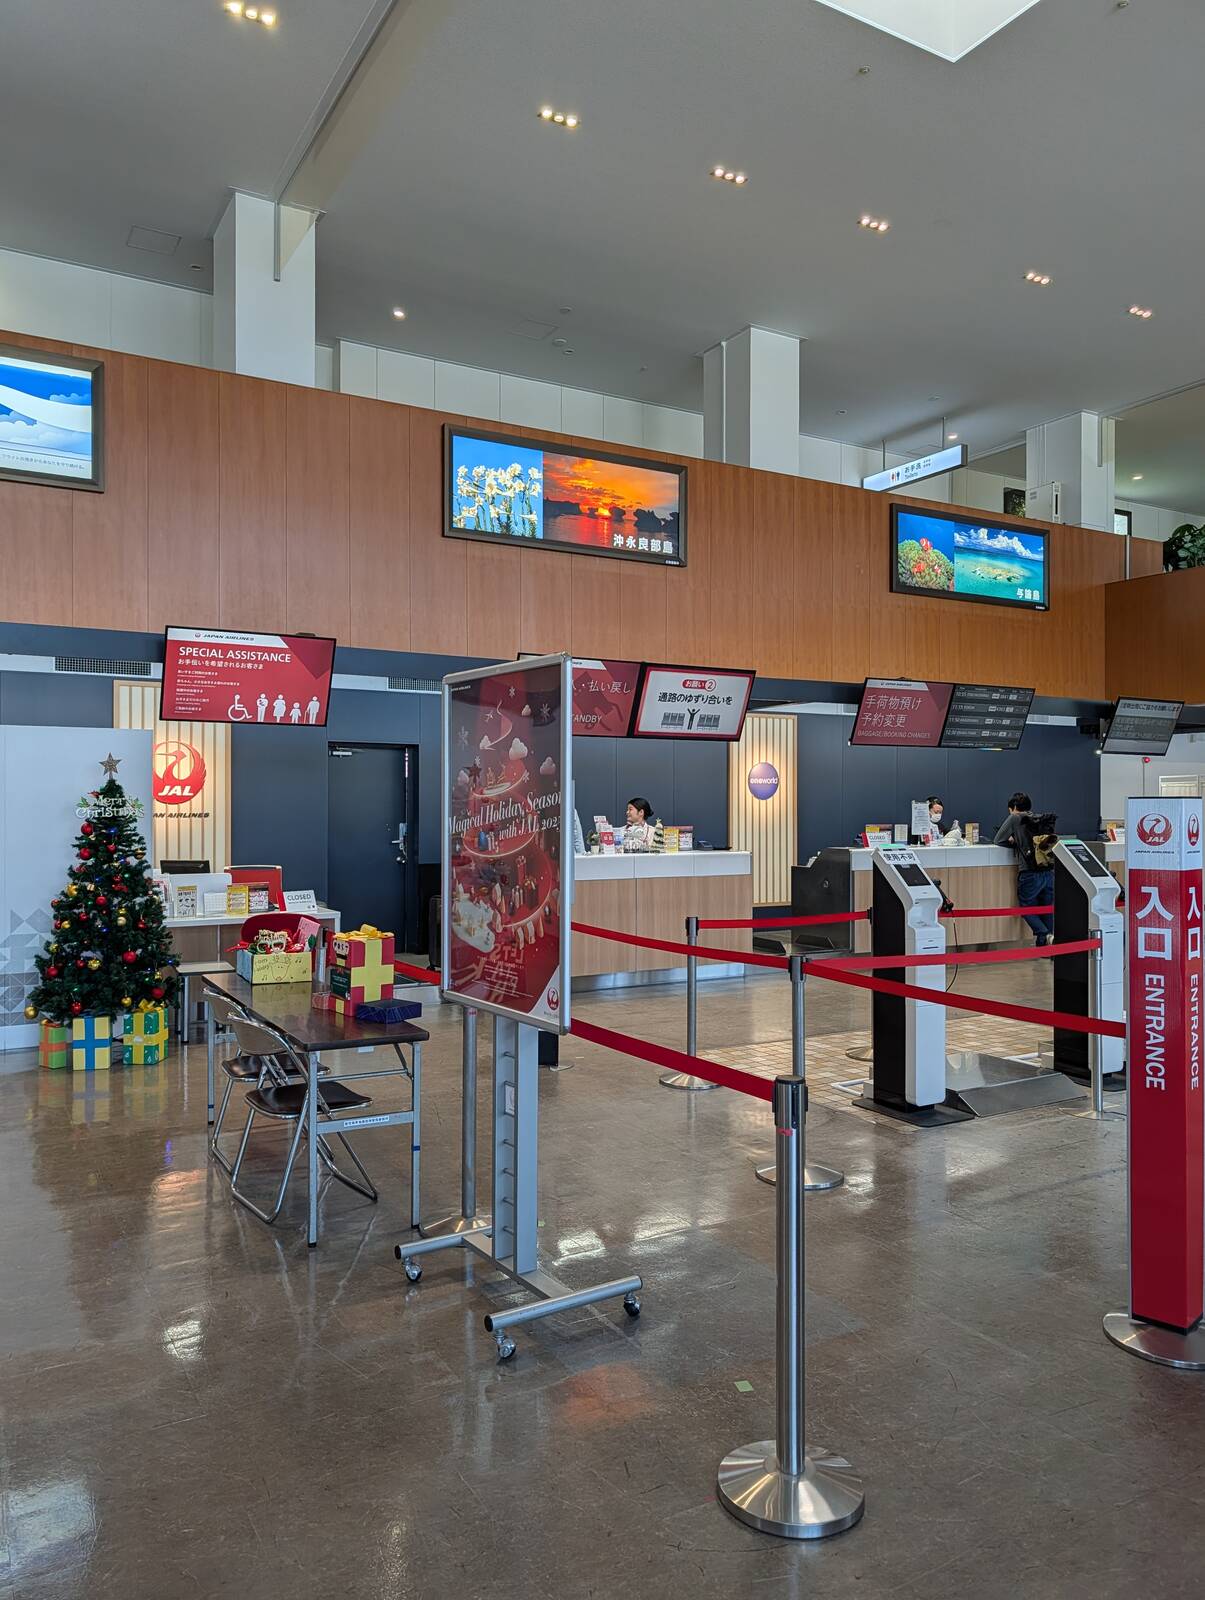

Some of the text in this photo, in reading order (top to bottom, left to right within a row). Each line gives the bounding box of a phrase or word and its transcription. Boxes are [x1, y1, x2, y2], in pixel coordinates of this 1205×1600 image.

[613, 533, 673, 554] 沖永良部島
[179, 646, 292, 663] SPECIAL ASSISTANCE
[657, 691, 733, 706] 通路のゆずり合いを
[865, 694, 923, 711] 手荷物預け
[861, 712, 908, 728] 予約変更
[750, 776, 778, 785] oneworld
[158, 785, 194, 797] JAL
[75, 805, 145, 821] Christmas
[486, 797, 525, 824] Holiday
[499, 820, 517, 841] with
[883, 853, 916, 862] 使用不可
[286, 893, 312, 901] CLOSED
[1135, 886, 1175, 961] 入口
[1144, 973, 1166, 1091] ENTRANCE
[1189, 973, 1200, 1091] ENTRANCE
